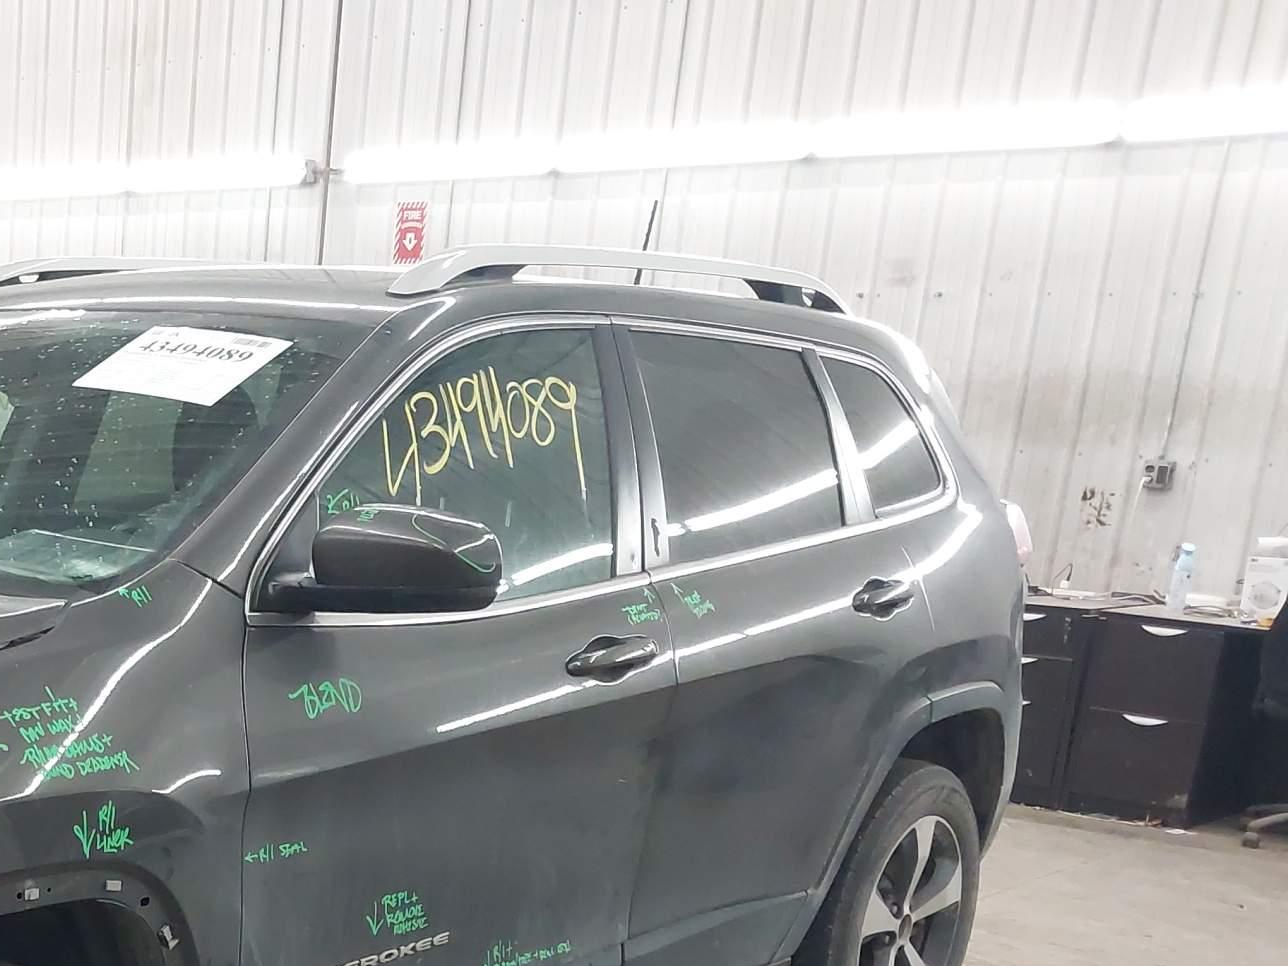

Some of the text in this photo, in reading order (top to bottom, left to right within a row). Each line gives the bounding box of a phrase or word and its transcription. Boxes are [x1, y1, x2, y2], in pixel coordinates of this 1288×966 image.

[403, 210, 422, 220] FIRE
[139, 340, 254, 363] 43494089
[381, 365, 588, 507] 43494089
